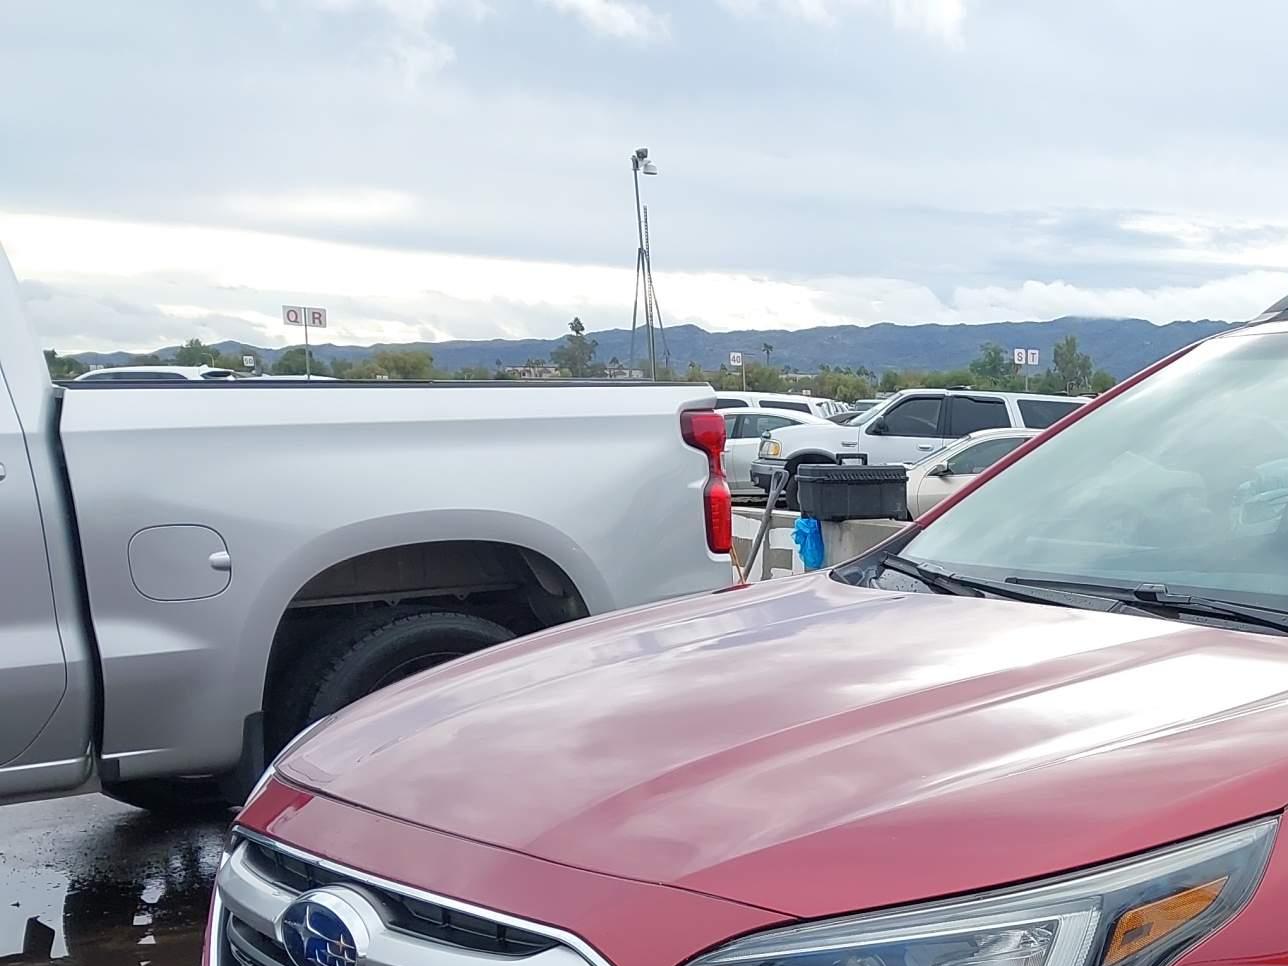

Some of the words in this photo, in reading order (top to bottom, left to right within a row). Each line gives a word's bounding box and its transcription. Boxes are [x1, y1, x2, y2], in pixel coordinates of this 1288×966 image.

[287, 309, 300, 323] Q
[312, 312, 322, 325] R
[1017, 352, 1024, 362] S
